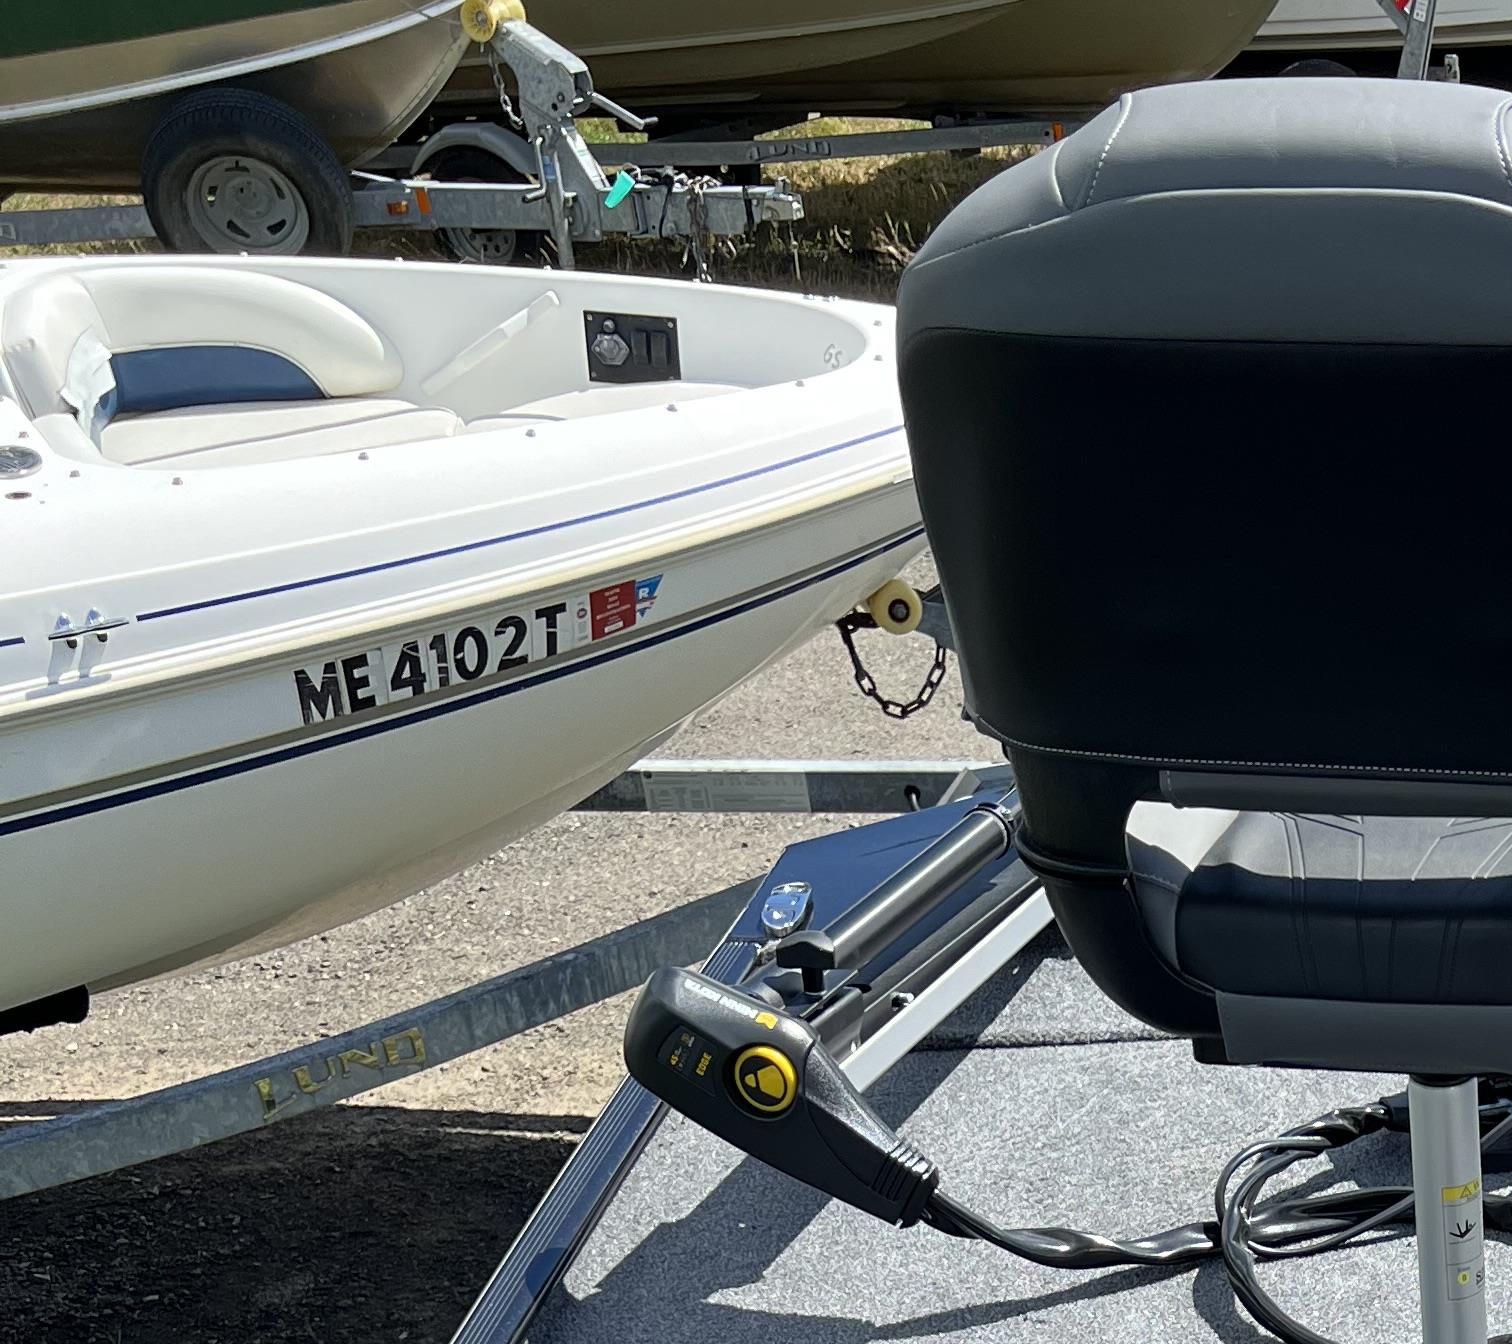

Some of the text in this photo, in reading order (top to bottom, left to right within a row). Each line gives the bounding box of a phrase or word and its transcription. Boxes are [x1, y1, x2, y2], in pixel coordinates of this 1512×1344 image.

[294, 653, 377, 726] ME
[391, 602, 568, 698] 4102T
[254, 1027, 428, 1122] LUND
